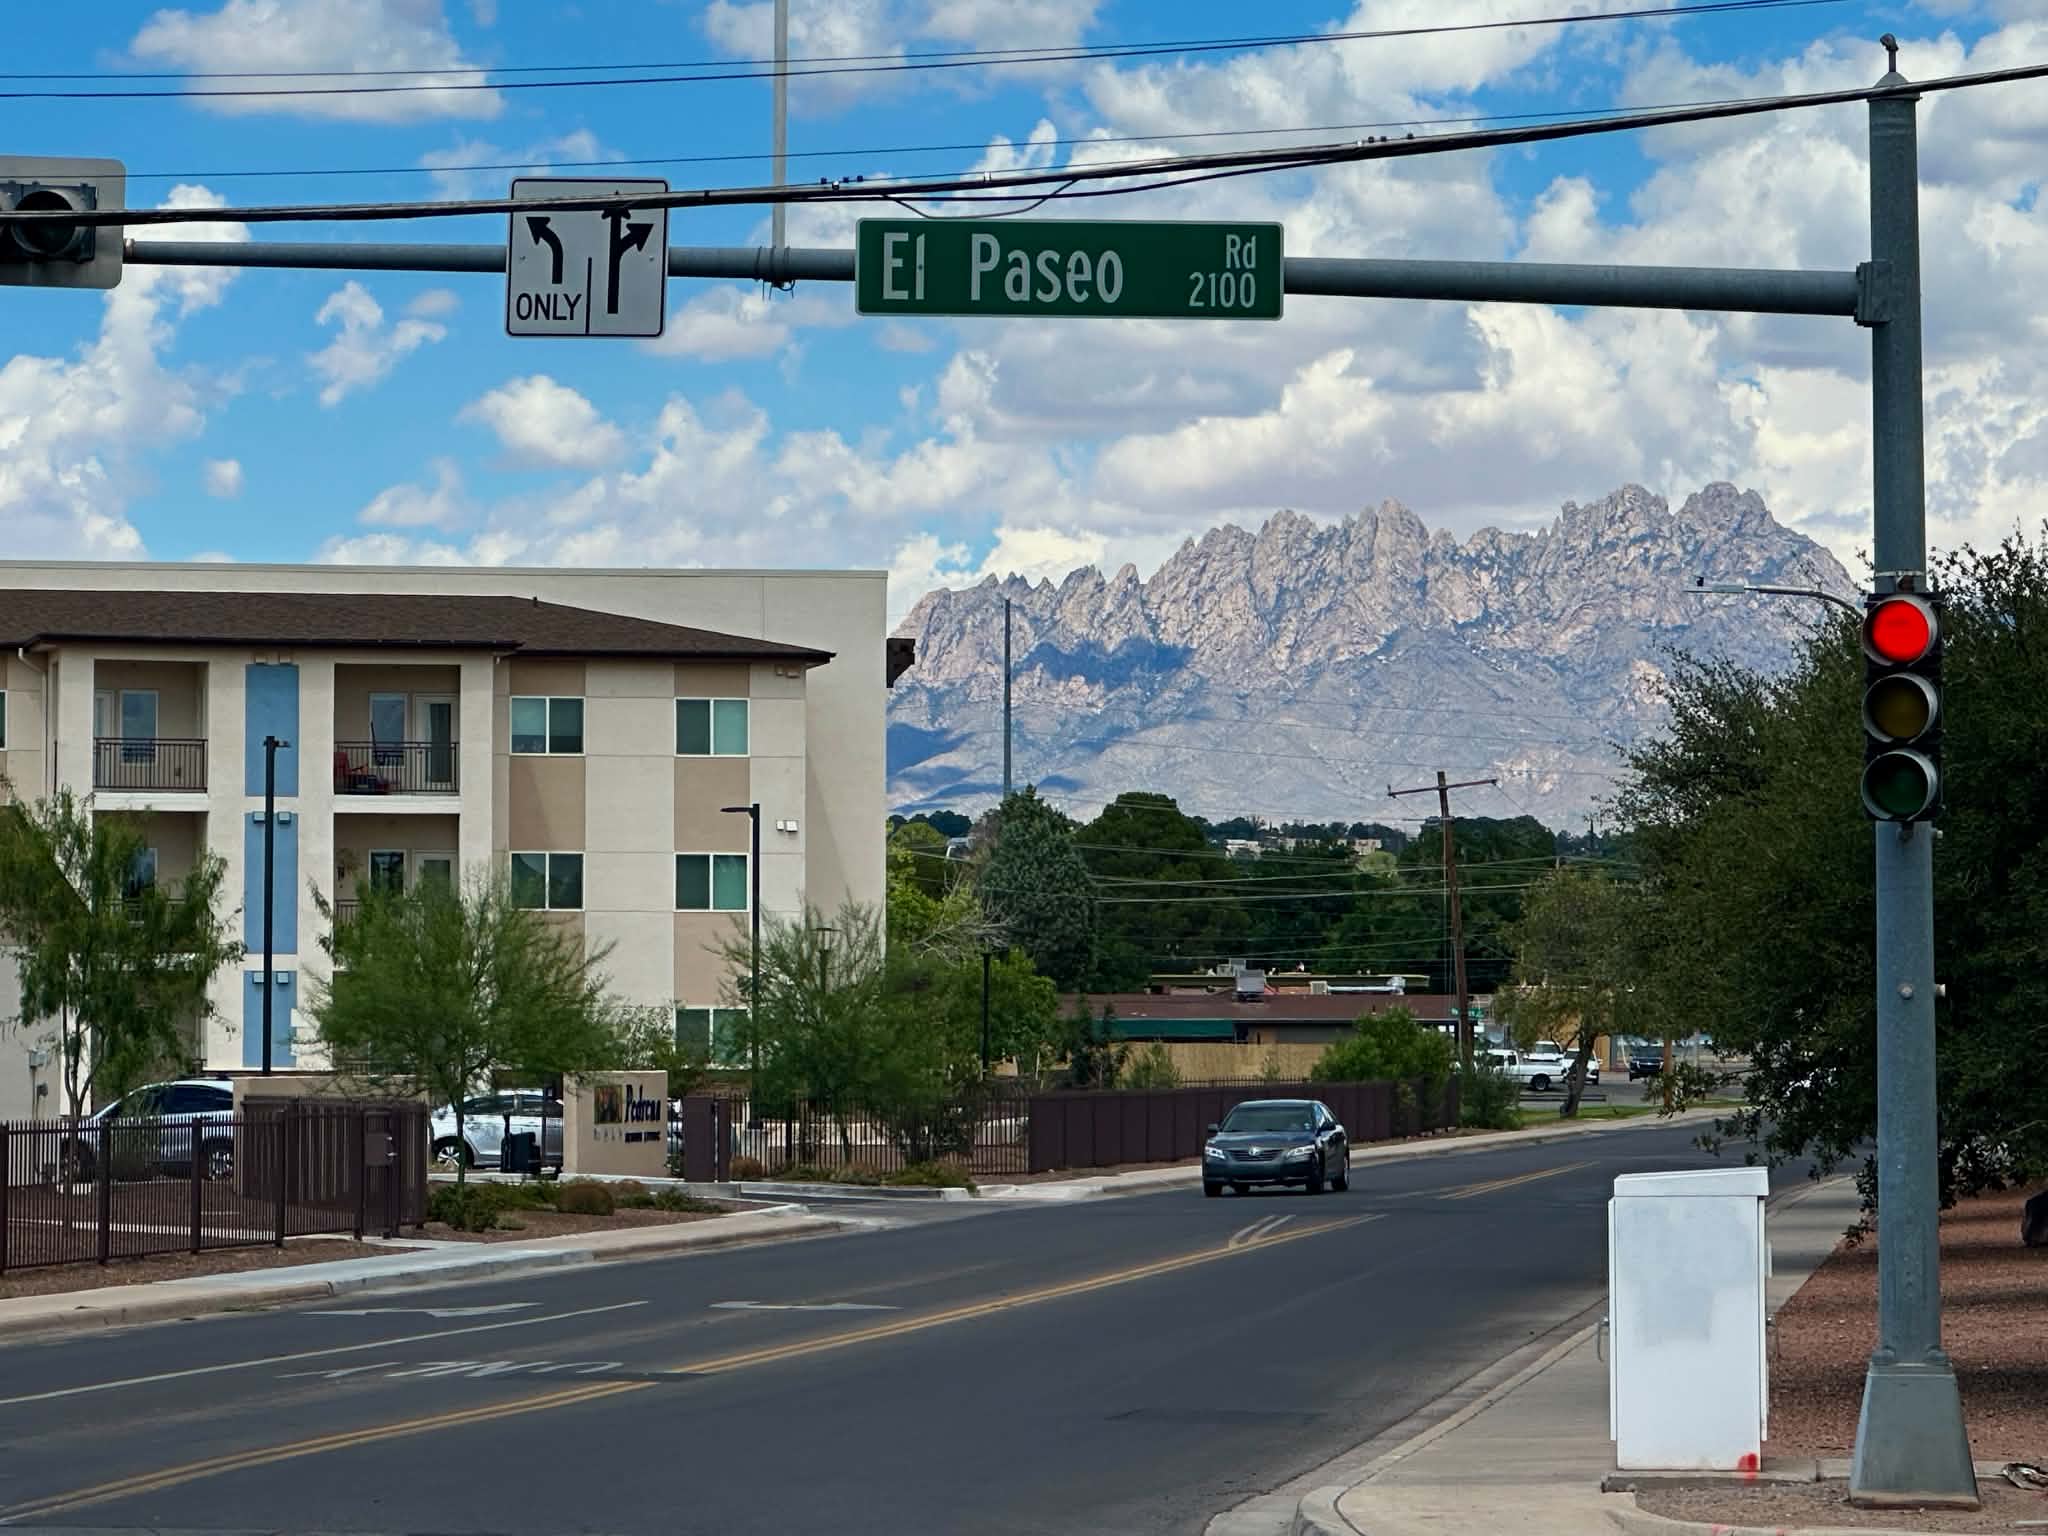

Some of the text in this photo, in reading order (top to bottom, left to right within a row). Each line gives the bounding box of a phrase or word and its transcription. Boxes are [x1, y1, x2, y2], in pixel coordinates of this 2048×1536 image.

[883, 232, 1124, 304] El Paseo
[1225, 234, 1257, 270] Rd
[516, 292, 583, 321] ONLY
[1188, 271, 1257, 308] 2100
